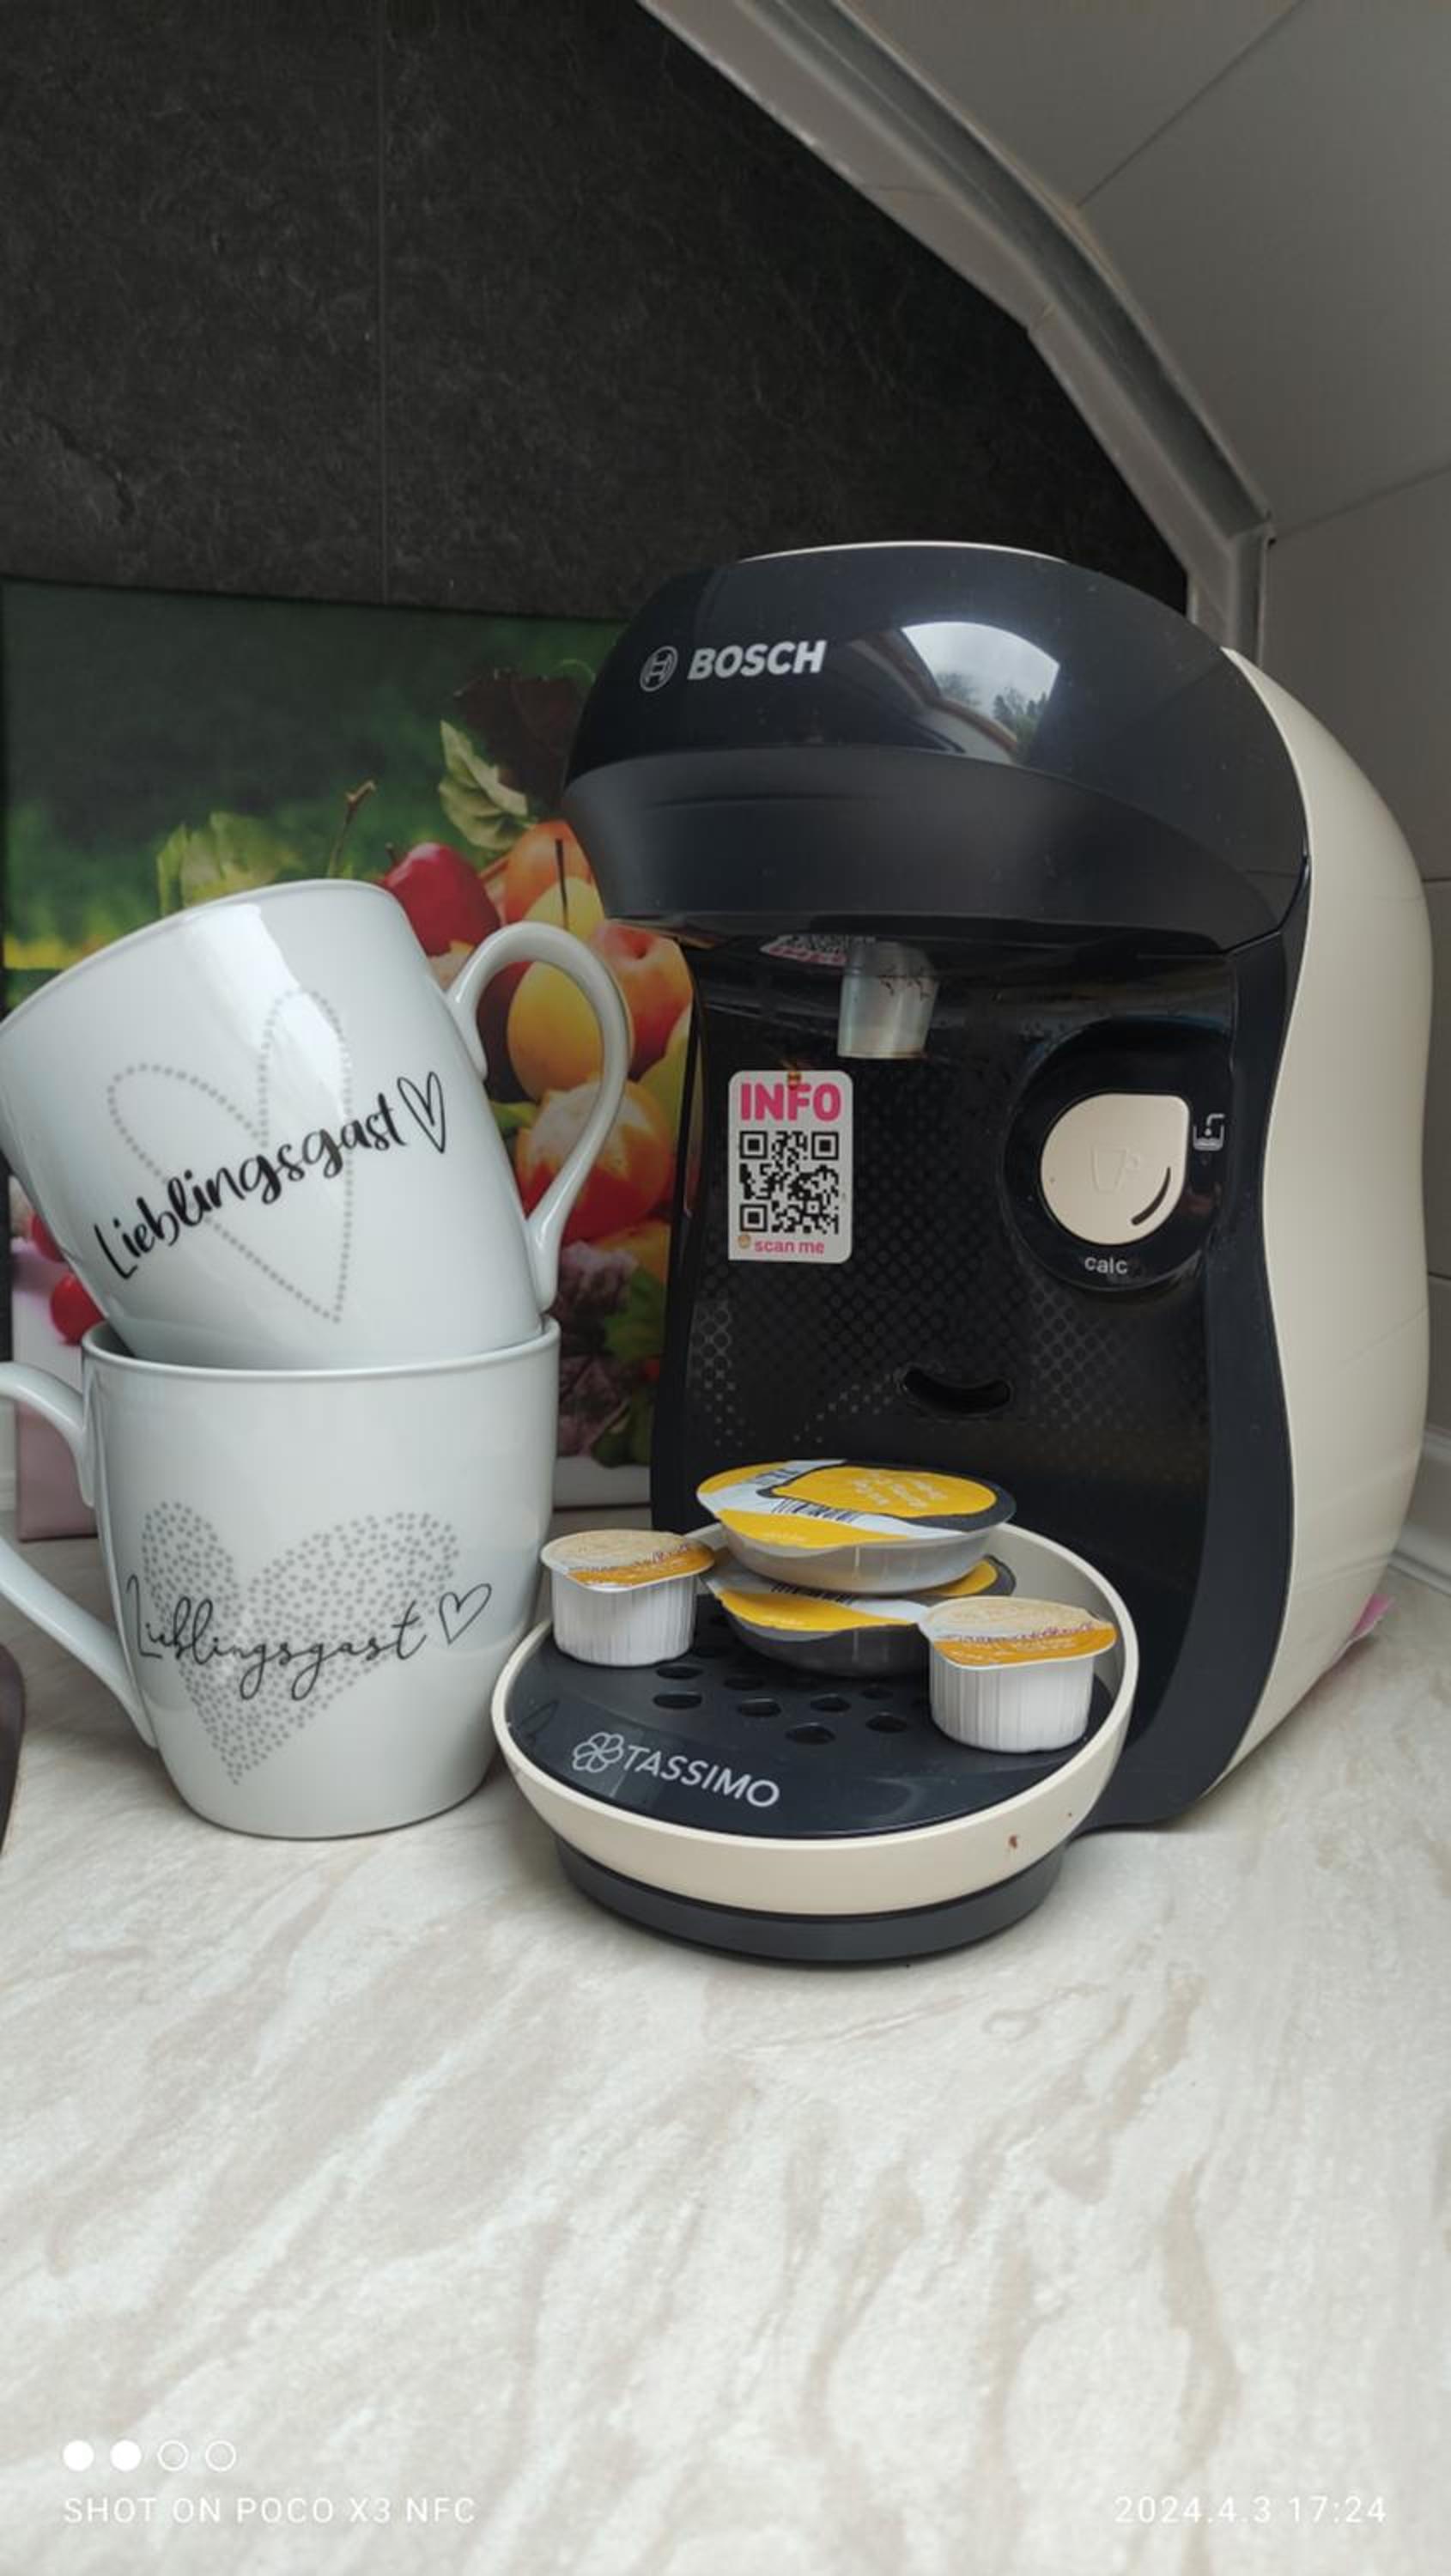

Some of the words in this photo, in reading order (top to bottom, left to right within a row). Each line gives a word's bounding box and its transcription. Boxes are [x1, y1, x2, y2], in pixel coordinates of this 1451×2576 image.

[687, 641, 828, 680] BOSCH
[740, 1082, 841, 1122] INFO
[94, 1092, 408, 1279] Lieblingsgast
[754, 1241, 795, 1255] scan
[798, 1242, 825, 1255] me
[1084, 1256, 1128, 1274] calc
[126, 1574, 427, 1700] Lieblingsgast
[623, 1745, 780, 1807] TASSIMO
